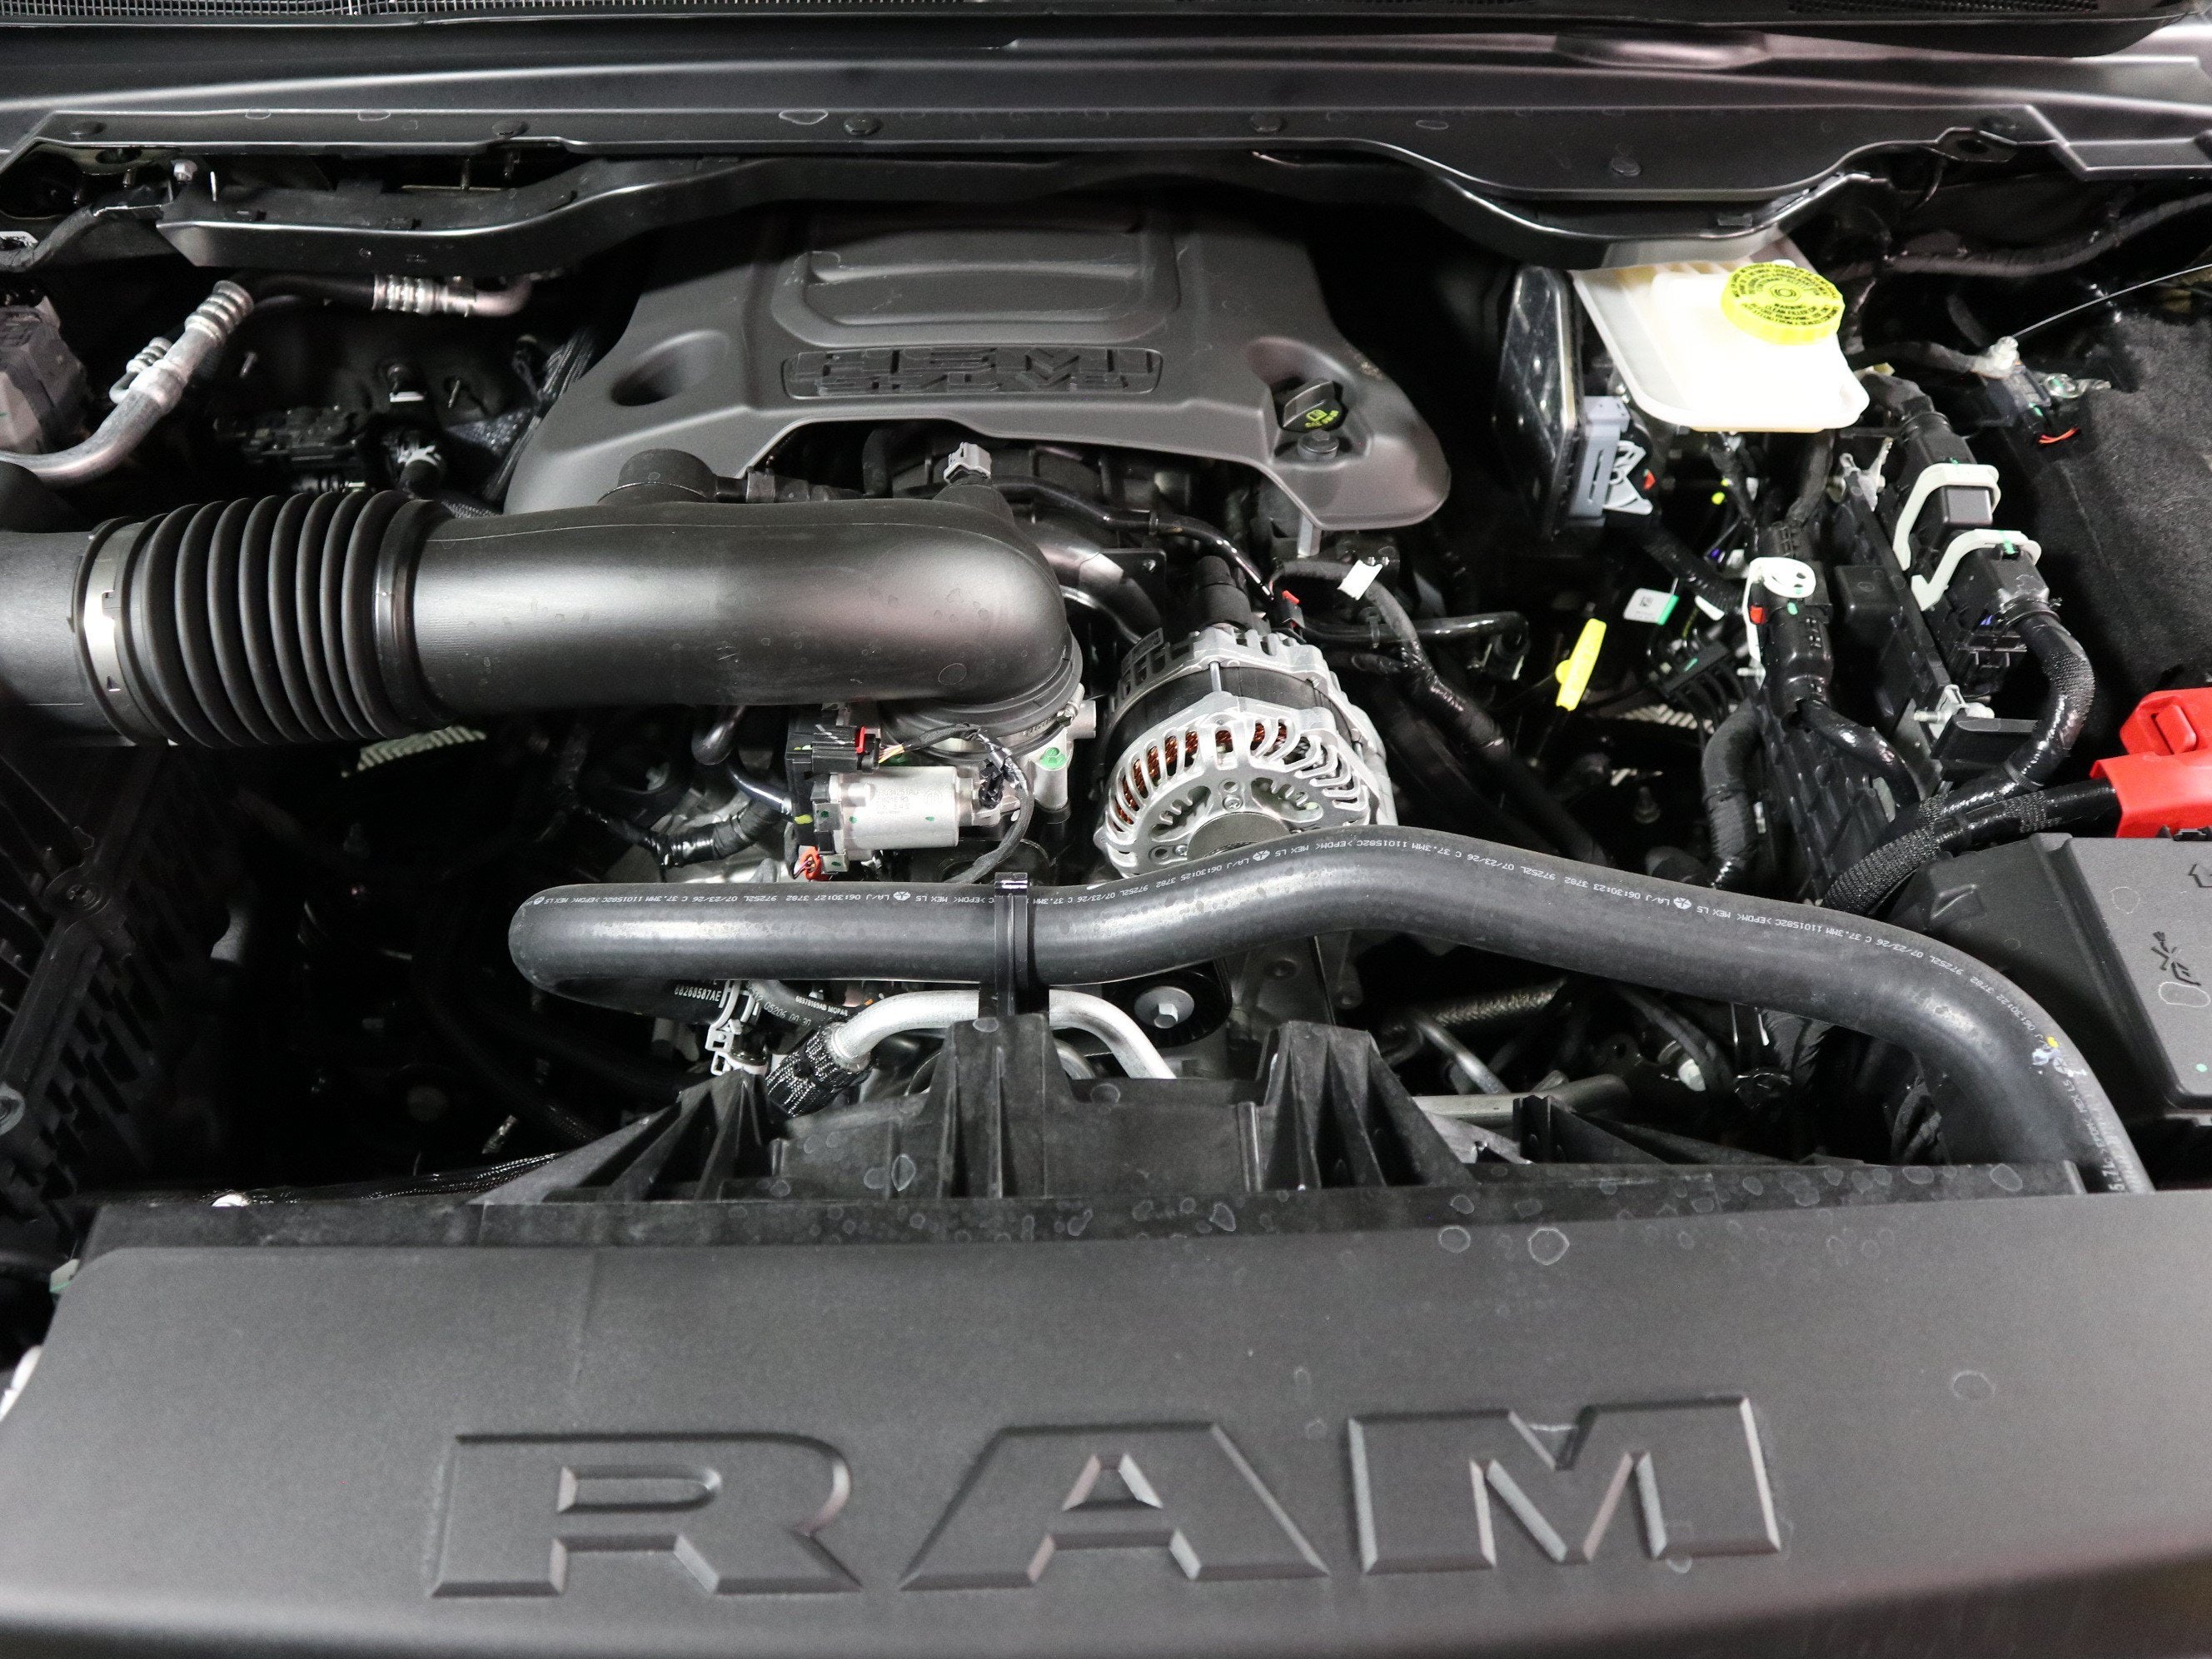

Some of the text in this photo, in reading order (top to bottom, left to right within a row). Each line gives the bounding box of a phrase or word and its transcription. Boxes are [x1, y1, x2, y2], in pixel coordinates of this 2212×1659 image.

[1290, 844, 1309, 854] MEX
[1357, 839, 1407, 848] 1101582C
[1411, 842, 1451, 855] 37.3MM
[1467, 854, 1515, 870] 07/23/26
[1520, 865, 1556, 880] 97252L
[1155, 876, 1176, 888] 3782
[1564, 876, 1589, 888] 3782
[1712, 909, 1731, 918] MEX
[1876, 939, 1924, 958] 07/23/26
[430, 1394, 1781, 1596] RAM
